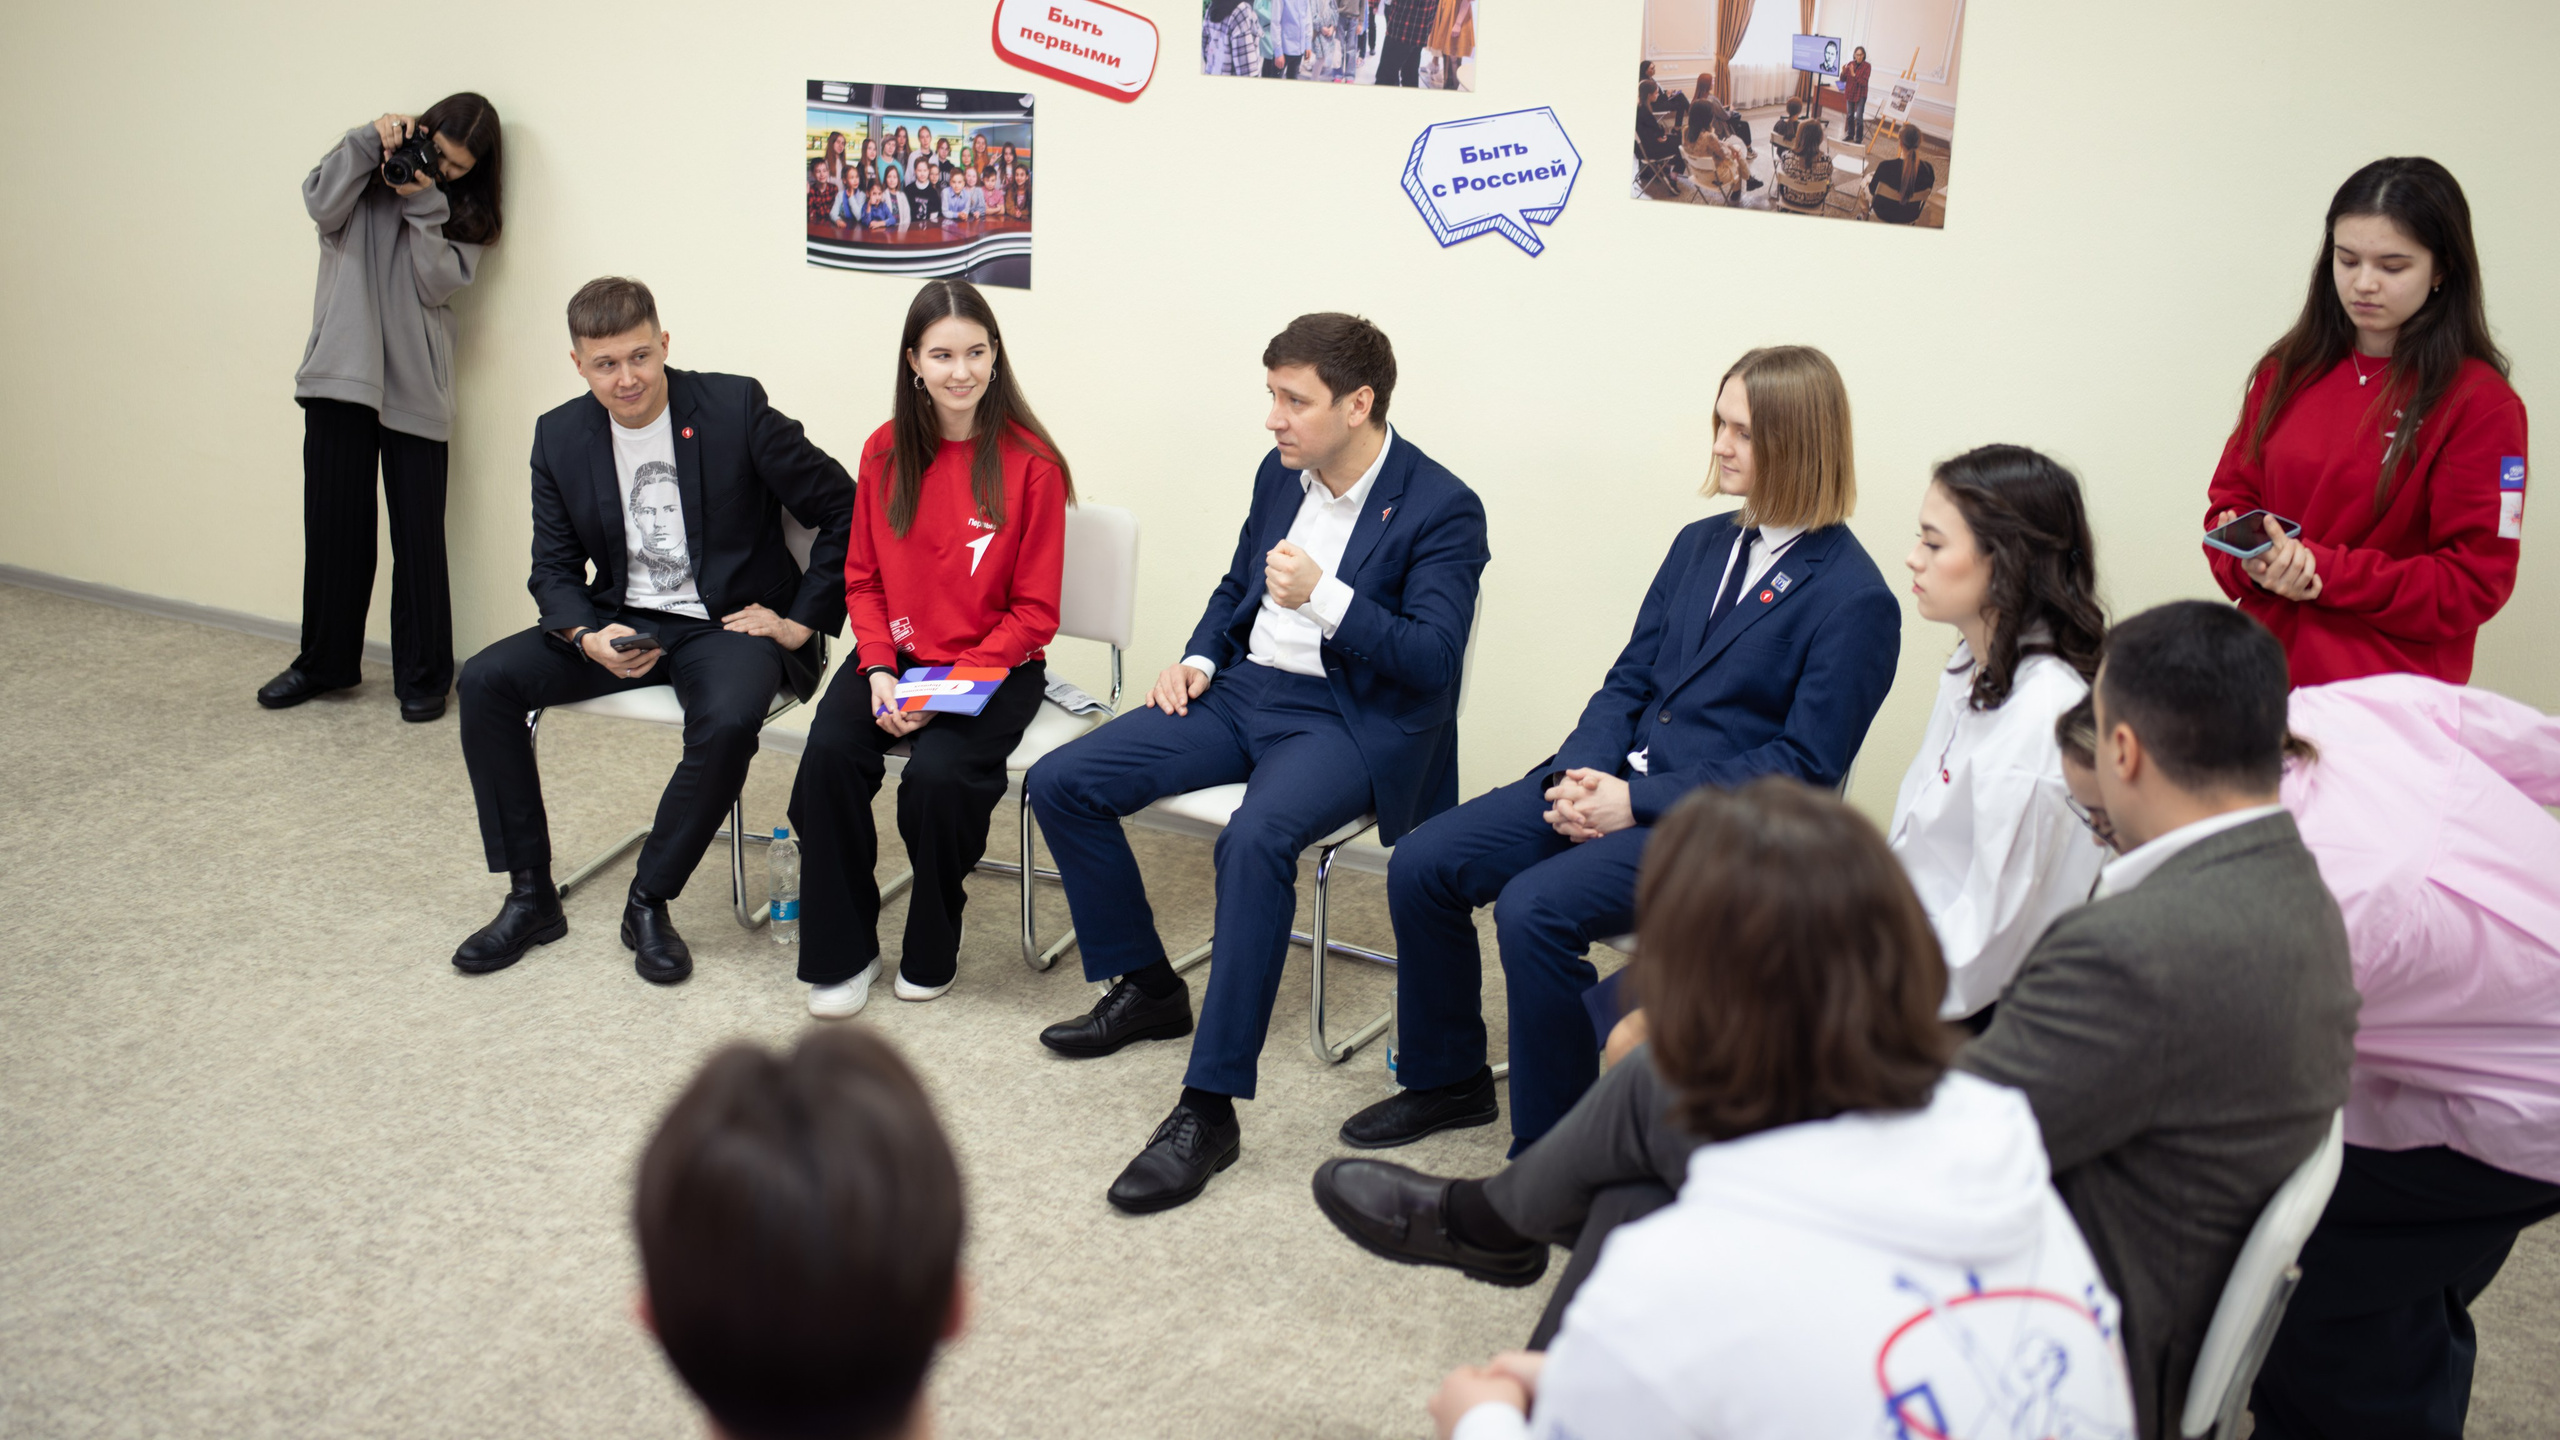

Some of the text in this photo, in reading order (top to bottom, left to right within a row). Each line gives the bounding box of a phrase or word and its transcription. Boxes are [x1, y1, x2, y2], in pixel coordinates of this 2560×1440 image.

[1047, 6, 1103, 37] Быть
[1019, 27, 1121, 69] первыми
[1459, 143, 1529, 165] Быть
[1431, 159, 1567, 198] с Россией
